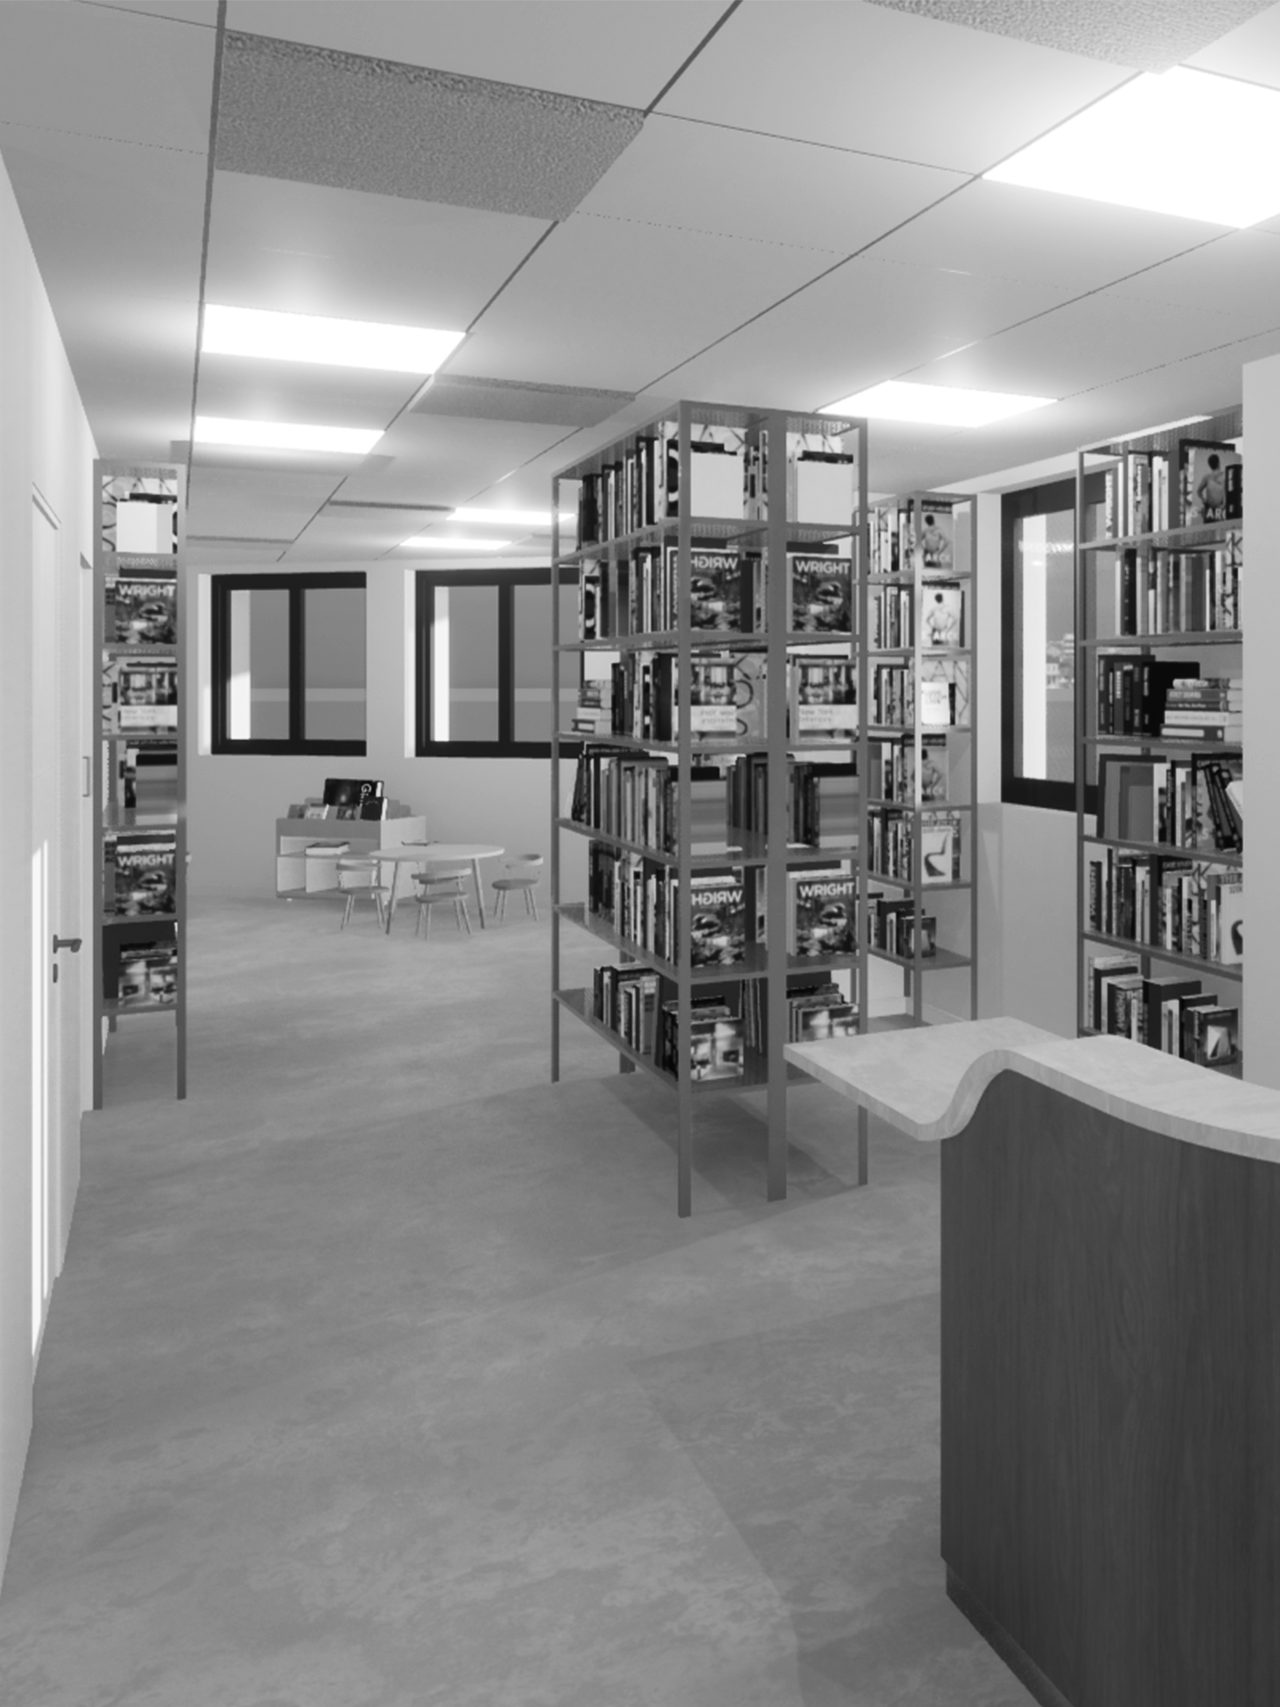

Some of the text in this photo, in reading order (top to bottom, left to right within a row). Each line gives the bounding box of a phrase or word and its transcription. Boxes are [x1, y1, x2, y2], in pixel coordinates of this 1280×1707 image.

[795, 560, 850, 575] WRIGHT
[118, 584, 175, 596] WRIGHT
[117, 853, 175, 866] WRIGHT
[799, 882, 854, 897] WRIGHT
